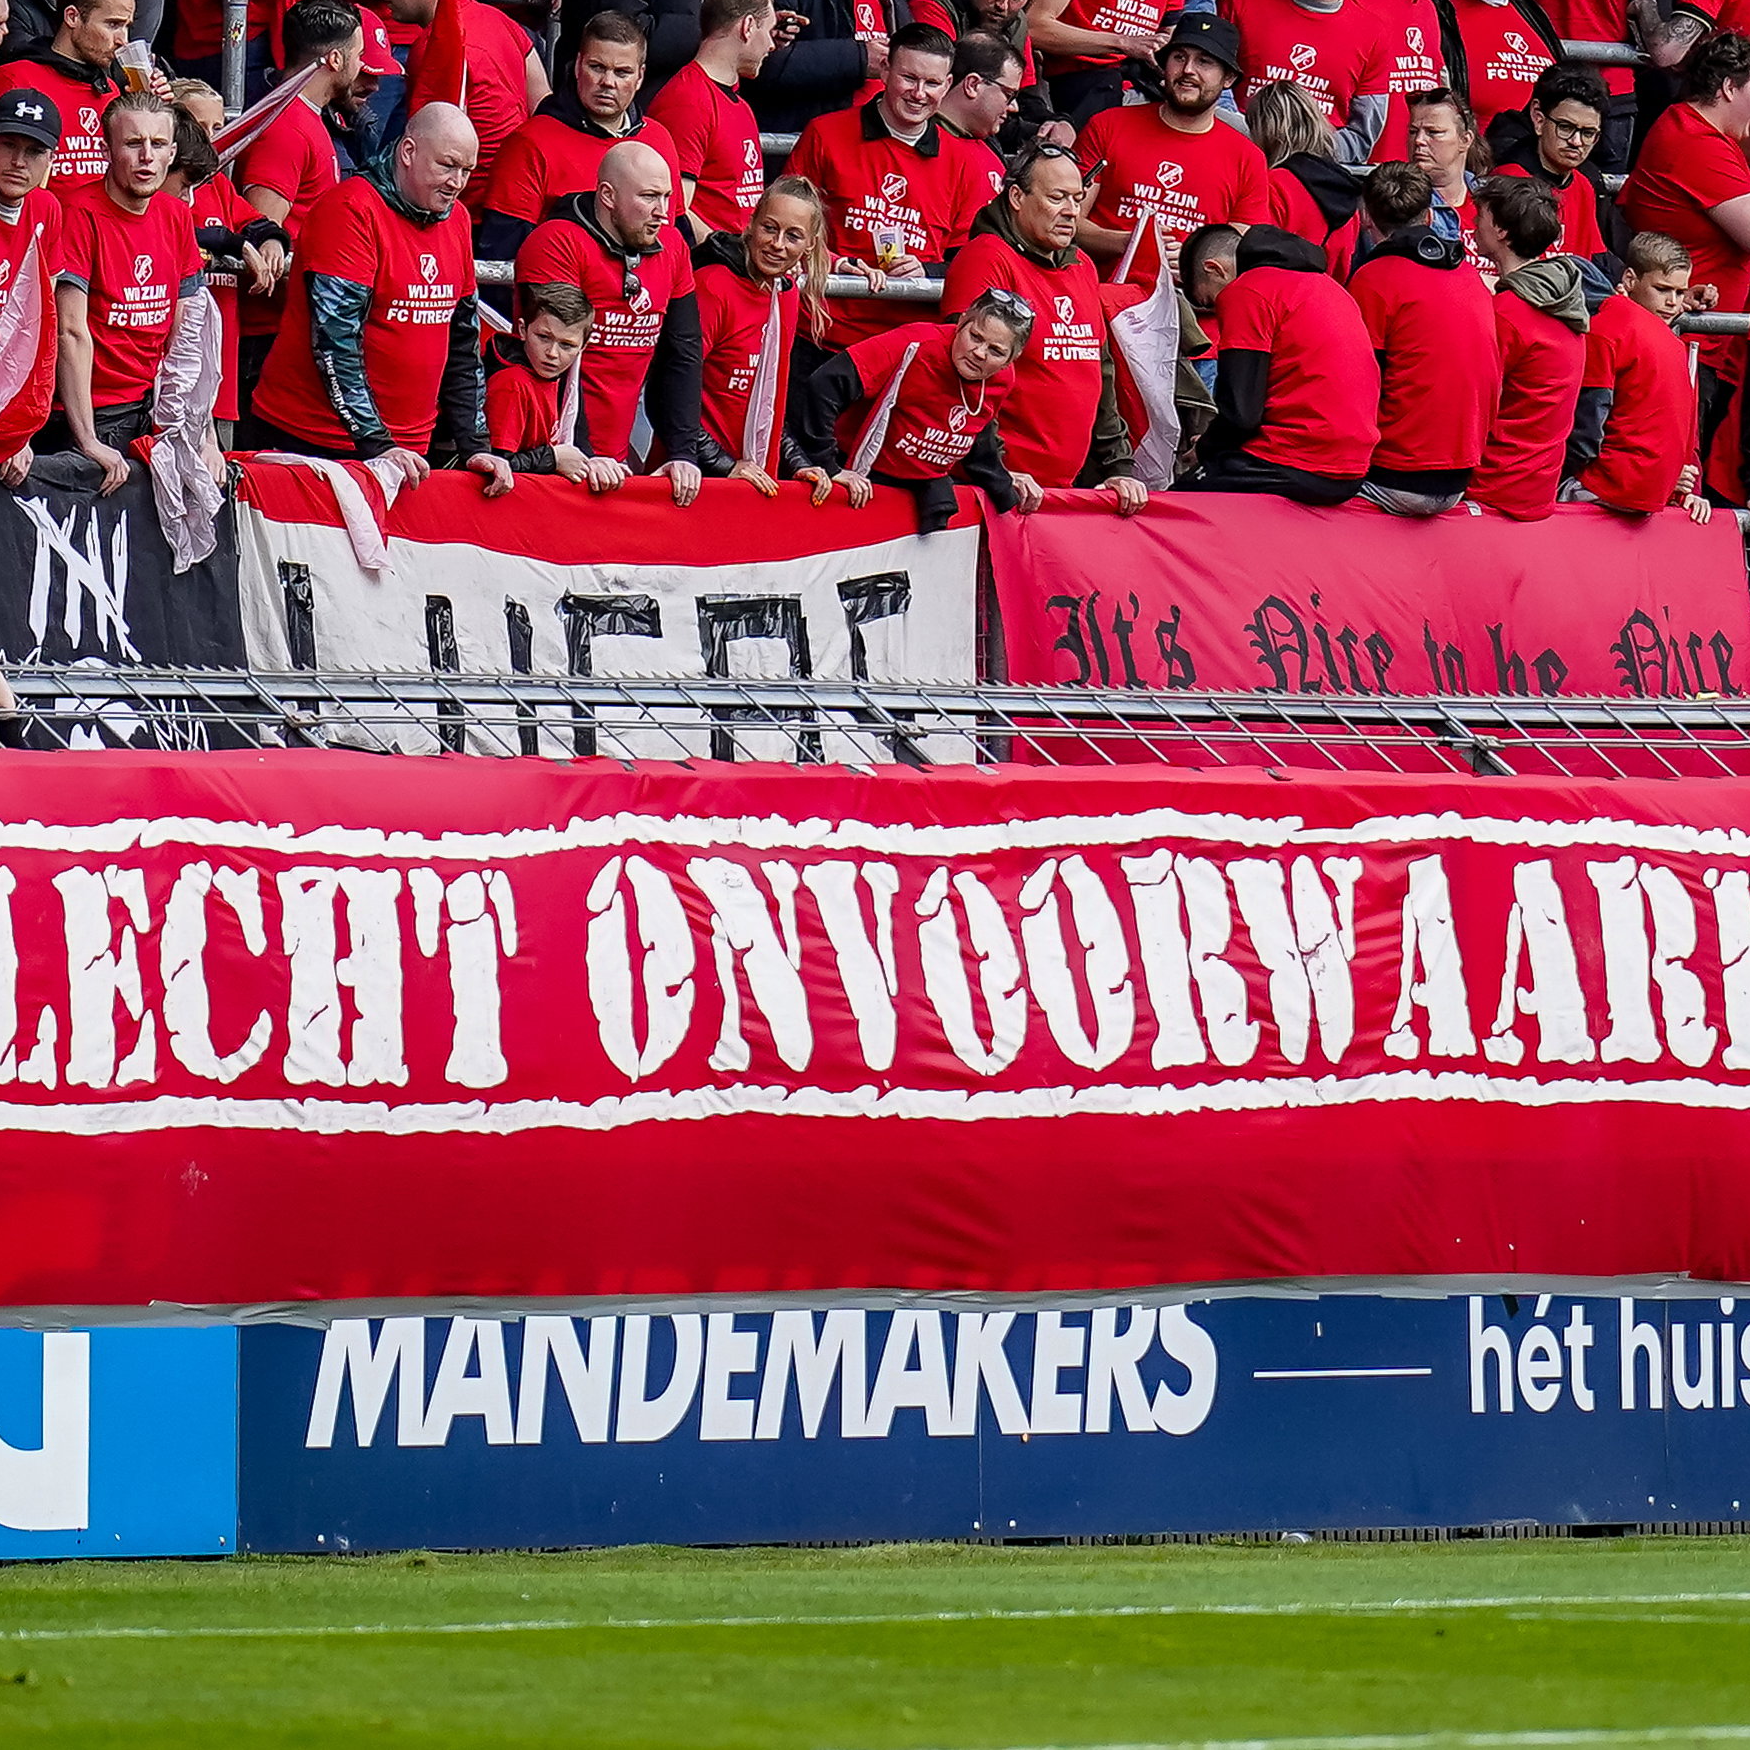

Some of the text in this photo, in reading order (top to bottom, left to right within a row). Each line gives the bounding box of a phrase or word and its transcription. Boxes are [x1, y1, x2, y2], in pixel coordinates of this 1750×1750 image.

[1137, 3, 1158, 20] ZIJN
[1092, 15, 1113, 28] FC
[1396, 56, 1418, 69] WIJ
[1497, 49, 1553, 67] WIJ ZIJN
[1267, 66, 1329, 93] WIJ ZIJN
[1487, 69, 1508, 79] FC
[1389, 80, 1402, 92] FC
[66, 137, 91, 150] WIJ
[49, 160, 73, 176] FC
[1134, 183, 1161, 200] WIJ
[1164, 190, 1198, 211] ZIJN
[884, 205, 920, 225] ZIJN
[1118, 205, 1134, 218] FC
[845, 216, 864, 230] FC
[124, 284, 167, 301] WIJ ZIJN
[408, 285, 453, 298] WIJ ZIJN
[108, 307, 170, 326] FC UTRECHT
[387, 308, 408, 322] FC
[605, 312, 631, 325] WIJ
[633, 314, 661, 329] ZIJN
[1052, 323, 1093, 338] WIJ ZIJN
[1044, 347, 1060, 360] FC
[896, 437, 917, 453] FC
[925, 428, 945, 443] WIJ
[943, 433, 974, 448] ZIJN
[1469, 1293, 1596, 1413] hét
[305, 1304, 1218, 1448] MANDEMAKERS
